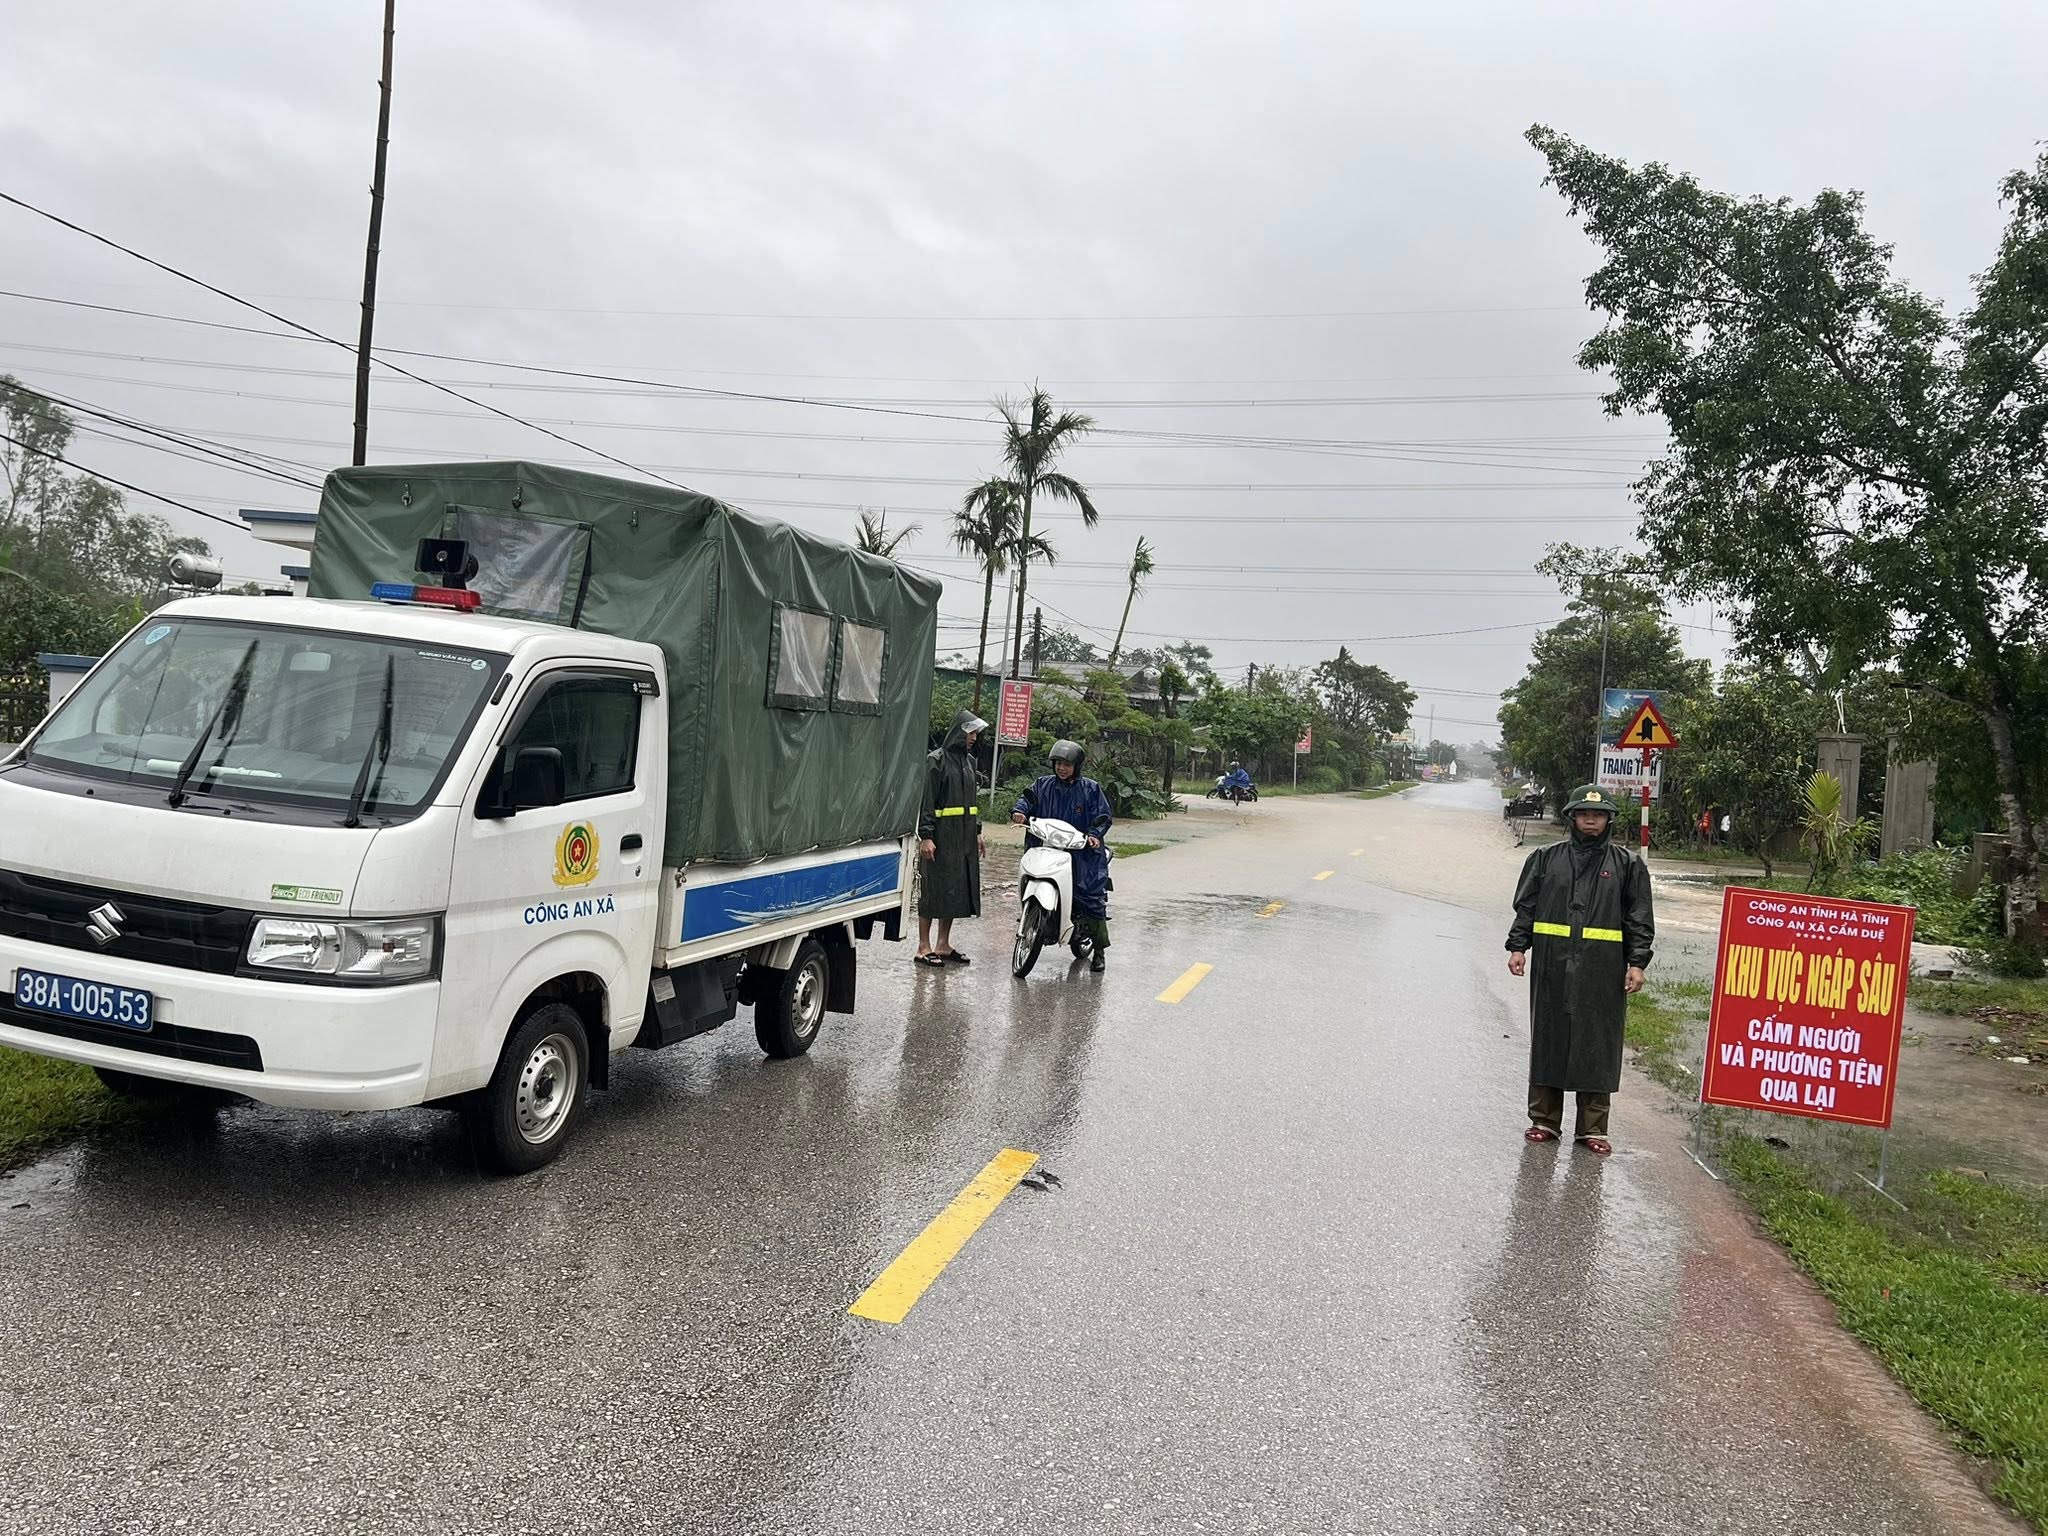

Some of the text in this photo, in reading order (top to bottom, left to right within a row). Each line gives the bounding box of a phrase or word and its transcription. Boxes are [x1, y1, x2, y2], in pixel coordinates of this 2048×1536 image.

[1603, 758, 1633, 775] TRANG
[311, 890, 341, 902] FRIENDLY
[524, 893, 615, 925] CÔNG AN XÃ
[1747, 915, 1885, 943] CÔNG AN XÃ CẨM DUỆ
[1749, 901, 1889, 926] CÔNG AN TỈNH HÀ TĨNH
[1725, 943, 1896, 1019] KHU VỰC NGẬP SÂU
[19, 973, 149, 1025] 38A-005.53
[1747, 1014, 1861, 1055] CẤM NGƯỜI
[1721, 1041, 1883, 1088] VÀ PHƯƠNG TIỆN
[1759, 1077, 1837, 1112] QUA LẠI
